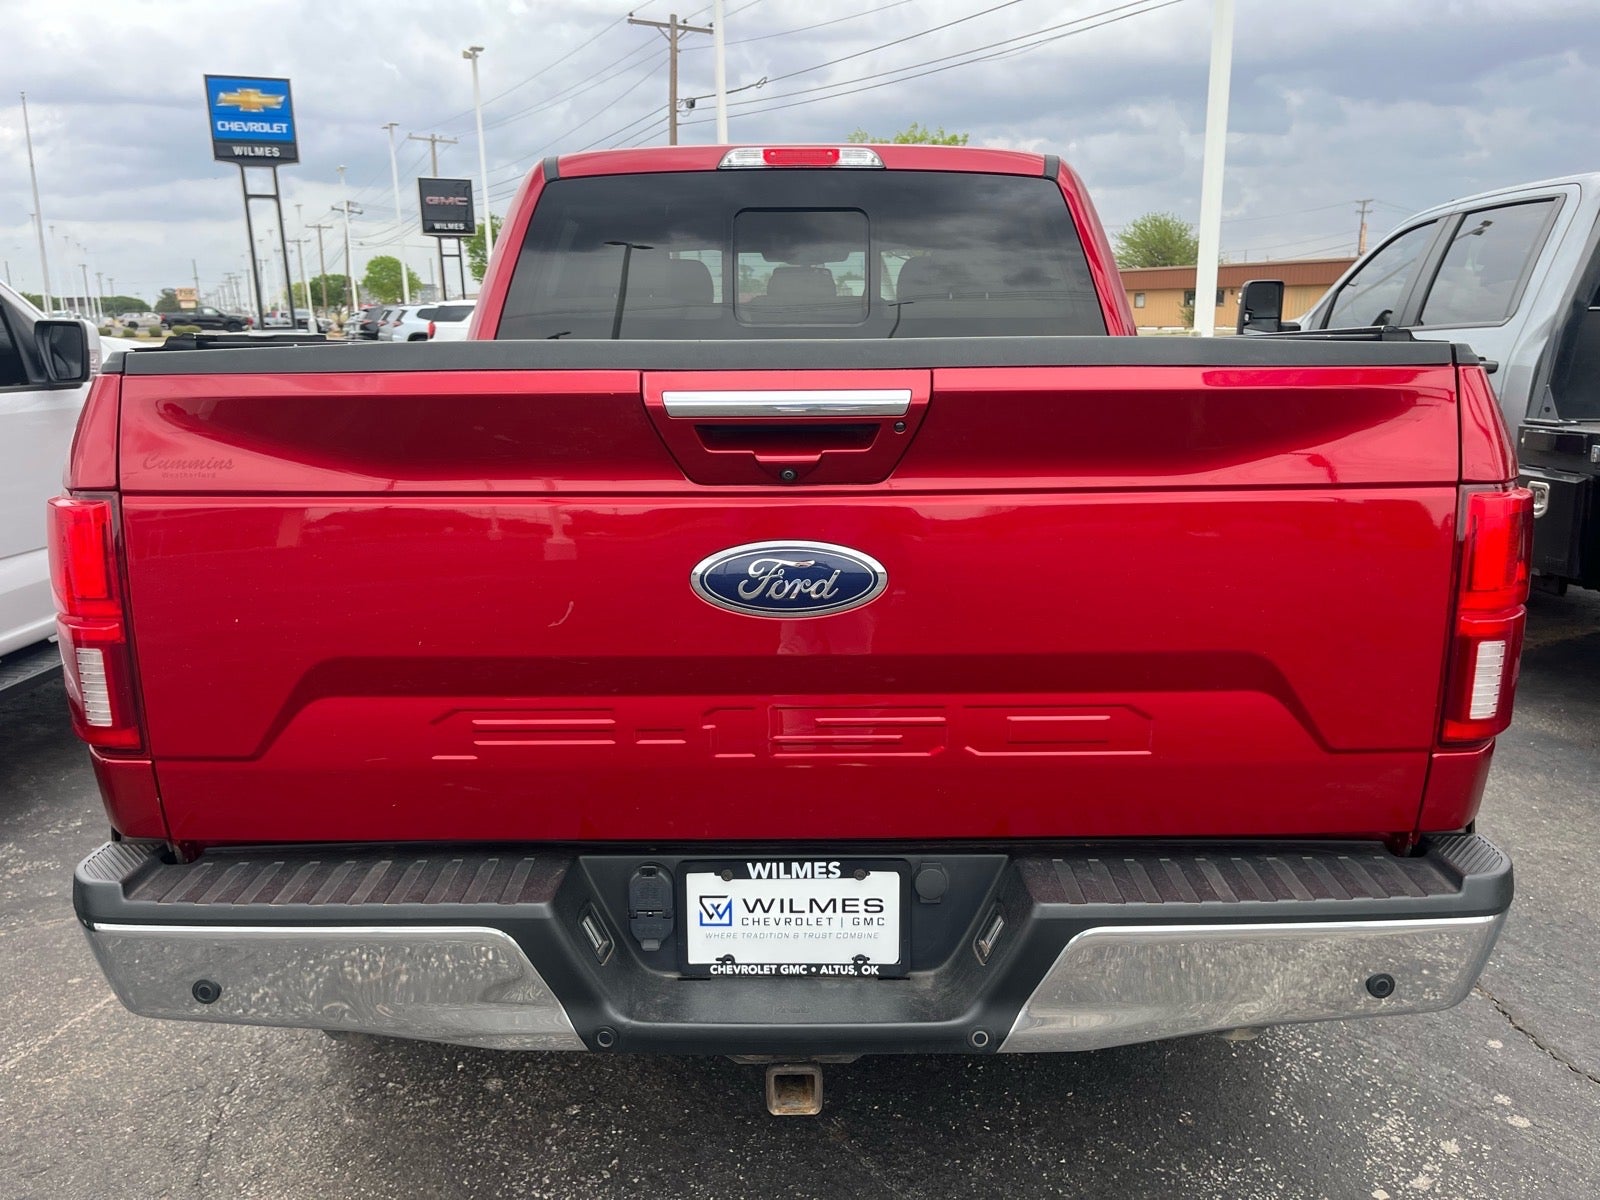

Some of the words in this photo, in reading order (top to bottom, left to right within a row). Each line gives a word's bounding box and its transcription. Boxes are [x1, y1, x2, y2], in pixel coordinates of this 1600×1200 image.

[217, 121, 289, 134] CHEVROLET
[232, 145, 280, 157] WILMES
[426, 196, 468, 205] GMC
[433, 222, 465, 230] WILMES
[142, 451, 235, 470] Cummins
[738, 558, 841, 600] Ford
[746, 861, 841, 880] WILMES
[742, 898, 885, 914] WILMES
[741, 917, 834, 927] CHEVROLET
[852, 917, 886, 927] GMC
[705, 932, 738, 940] WHERE
[742, 932, 789, 940] TRADITION
[803, 932, 833, 940] TRUST
[835, 932, 880, 940] COMBINE
[709, 964, 779, 975] CHEVROLET
[780, 964, 808, 975] GMC
[820, 964, 858, 976] ALTUS,
[862, 964, 880, 976] OK
